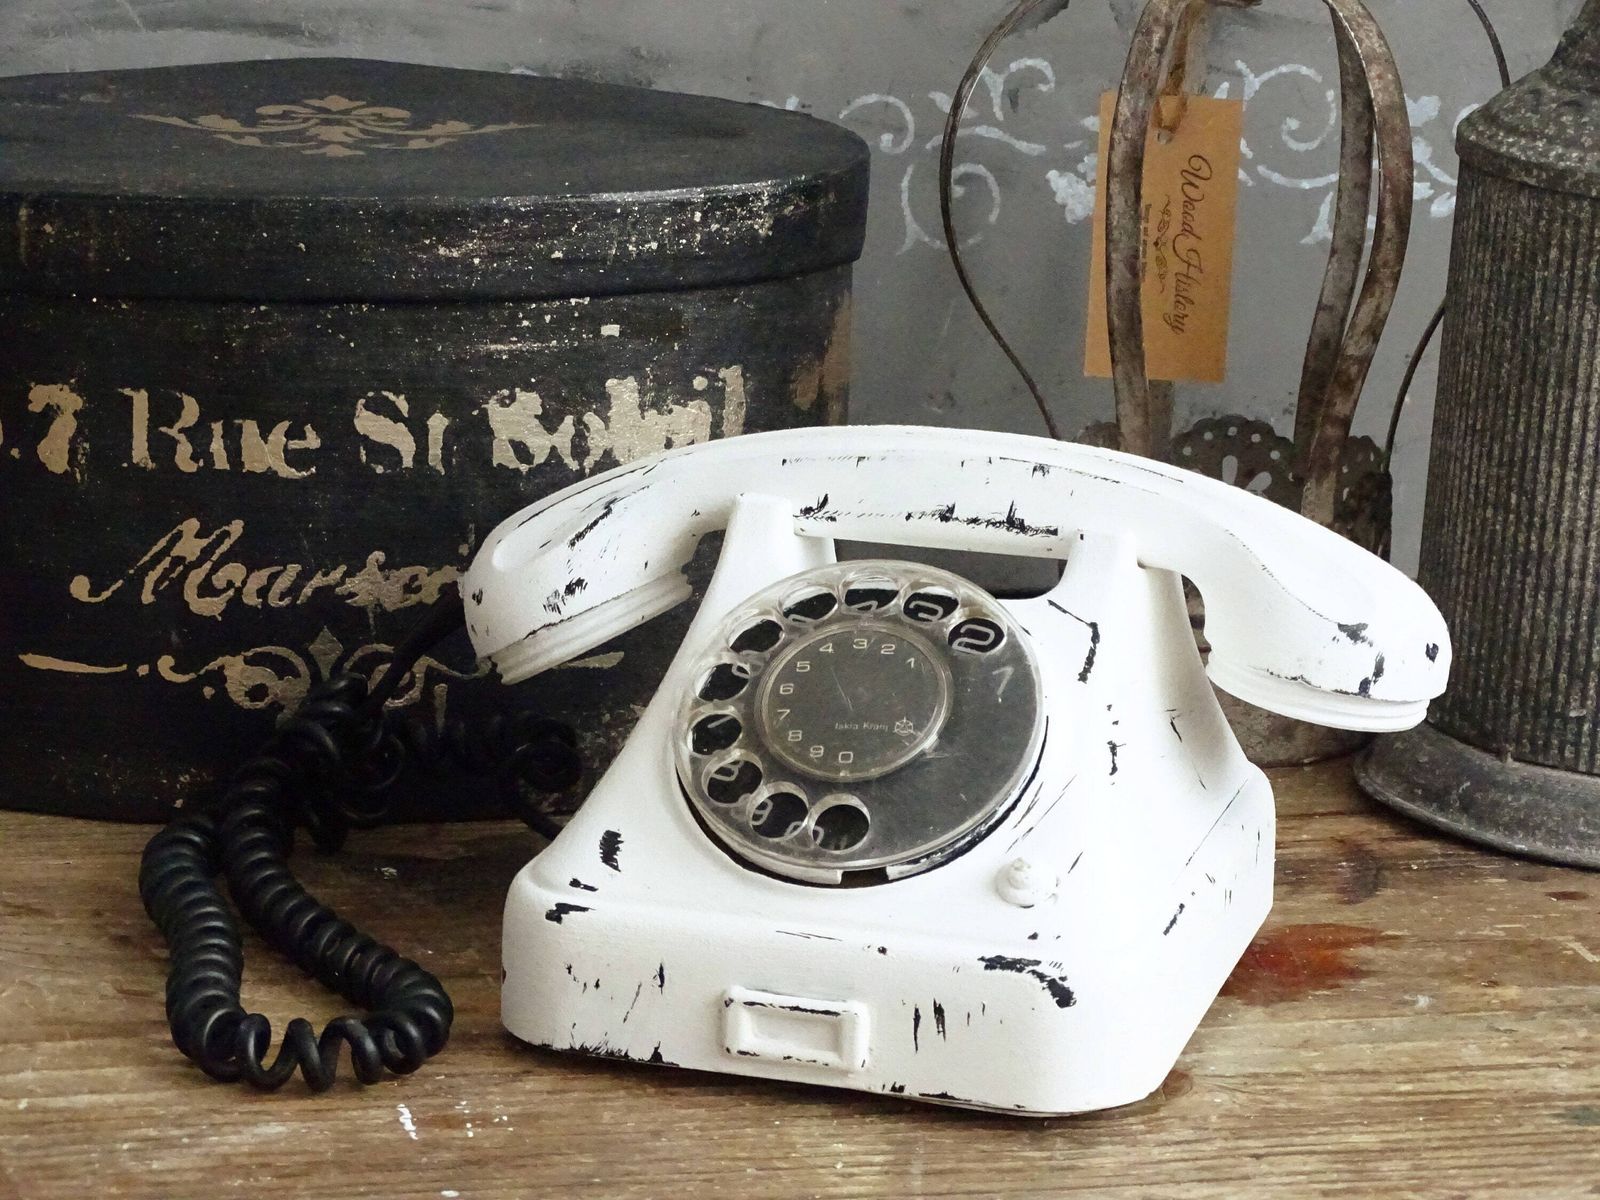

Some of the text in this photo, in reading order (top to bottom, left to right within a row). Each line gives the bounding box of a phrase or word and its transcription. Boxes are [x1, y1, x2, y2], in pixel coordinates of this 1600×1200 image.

[118, 387, 321, 479] Rue
[819, 642, 834, 653] 4
[853, 639, 867, 649] 3
[881, 644, 895, 654] 2
[796, 661, 810, 672] 5
[906, 658, 915, 668] 1
[780, 684, 794, 694] 6
[777, 710, 790, 720] 7
[788, 731, 802, 741] 8
[810, 746, 824, 757] 9
[839, 752, 853, 763] 0
